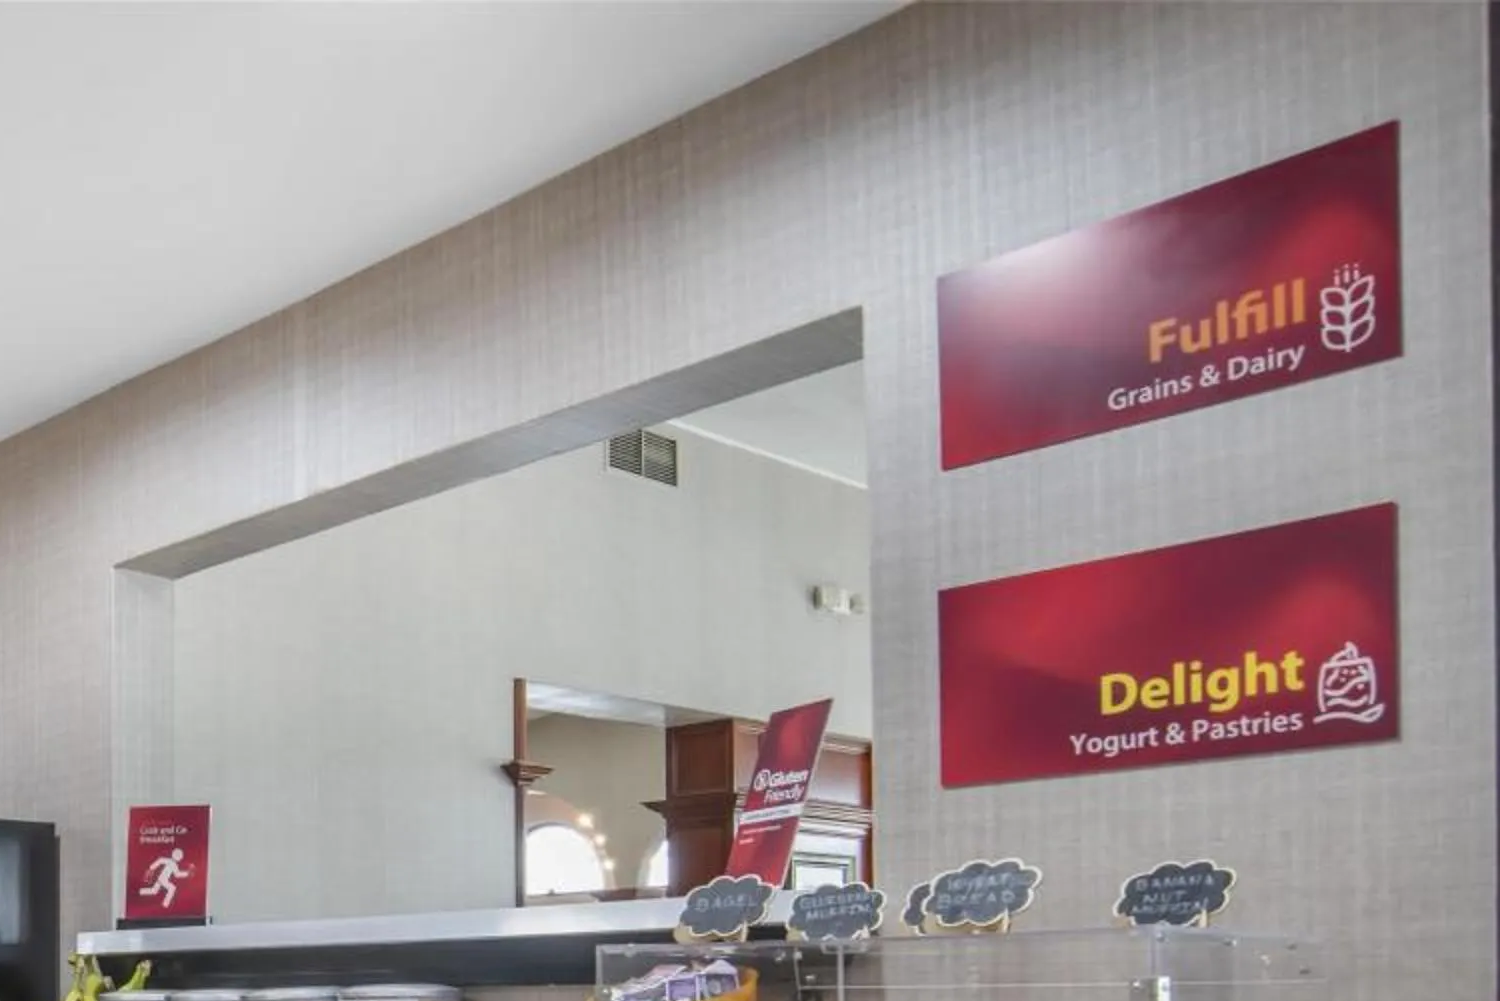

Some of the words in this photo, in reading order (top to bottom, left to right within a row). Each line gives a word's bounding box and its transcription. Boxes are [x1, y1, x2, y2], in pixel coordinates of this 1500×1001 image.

[1148, 278, 1307, 363] Fulfill
[1107, 374, 1192, 411] Grains
[1199, 364, 1221, 389] &
[1227, 344, 1305, 381] Dairy
[1100, 650, 1306, 716] Delight
[1070, 727, 1159, 757] Yogurt
[1165, 722, 1186, 746] &
[1192, 711, 1304, 742] Pastries
[770, 770, 809, 788] Gluten
[1136, 874, 1214, 891] BANANA
